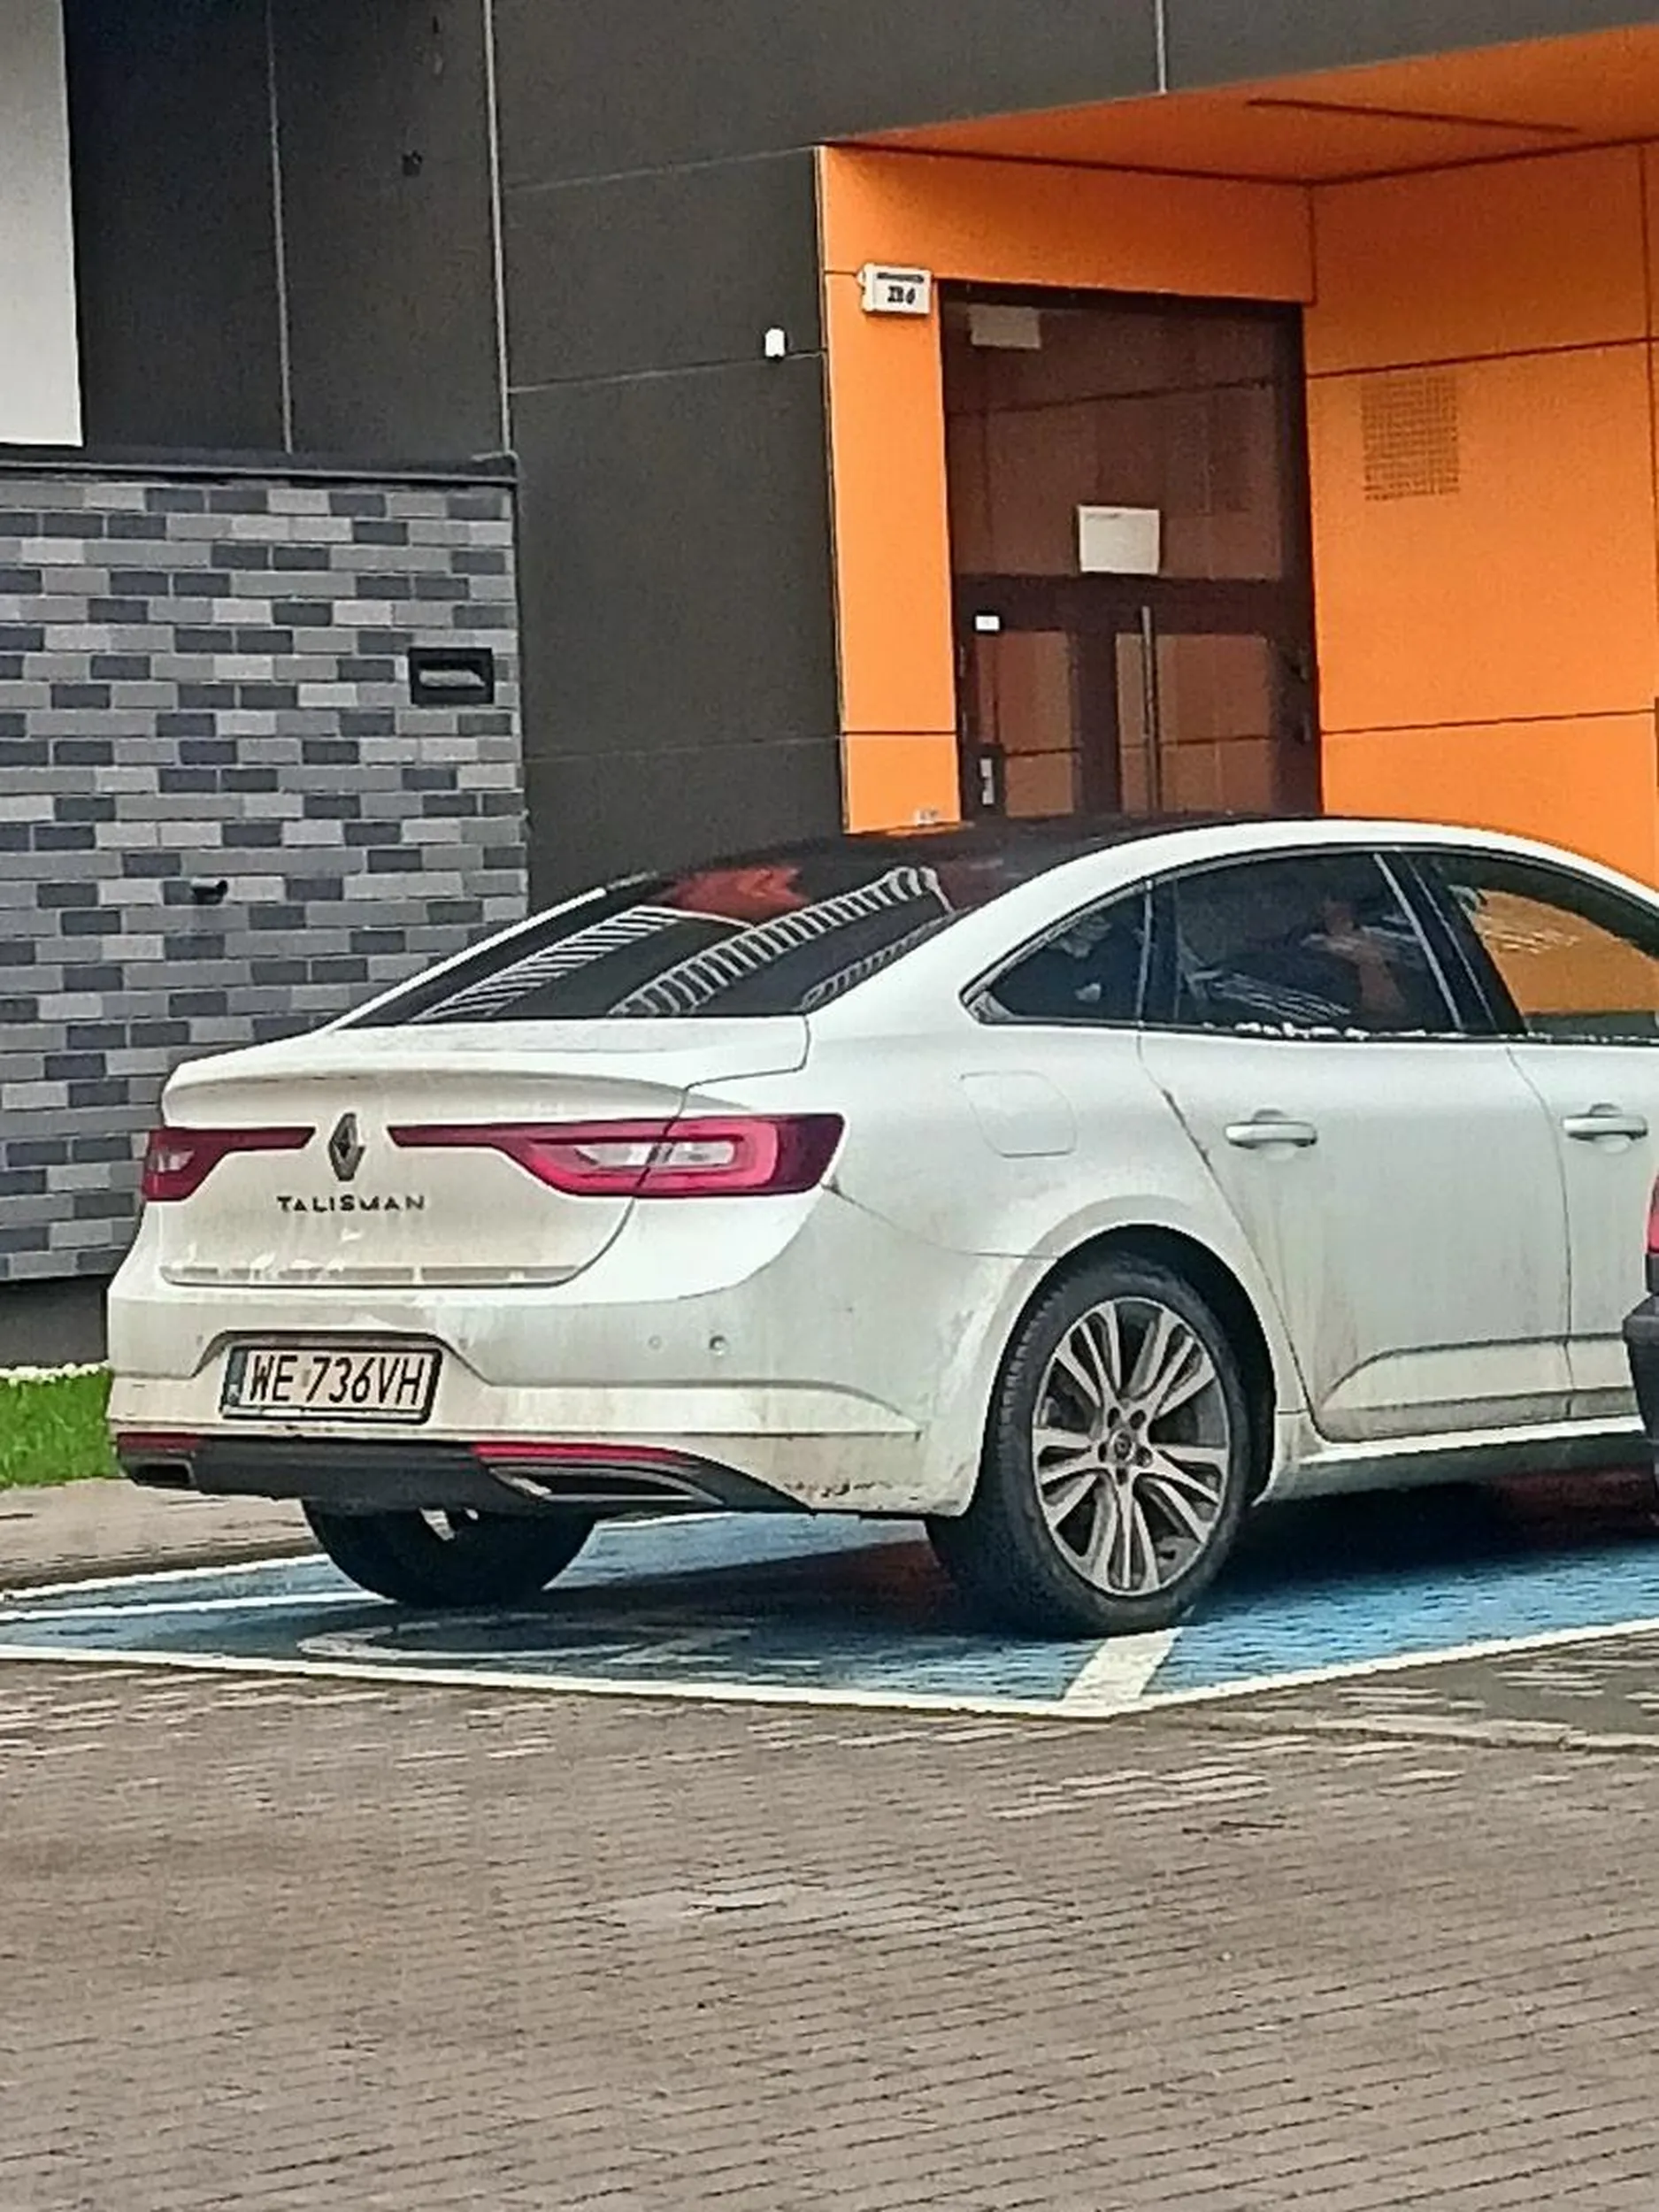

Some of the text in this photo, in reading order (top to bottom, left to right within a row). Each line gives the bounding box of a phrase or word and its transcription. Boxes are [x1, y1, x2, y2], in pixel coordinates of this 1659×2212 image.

[276, 1194, 425, 1212] TALISMAN
[250, 1355, 298, 1402] WE
[306, 1356, 425, 1404] 736VH
